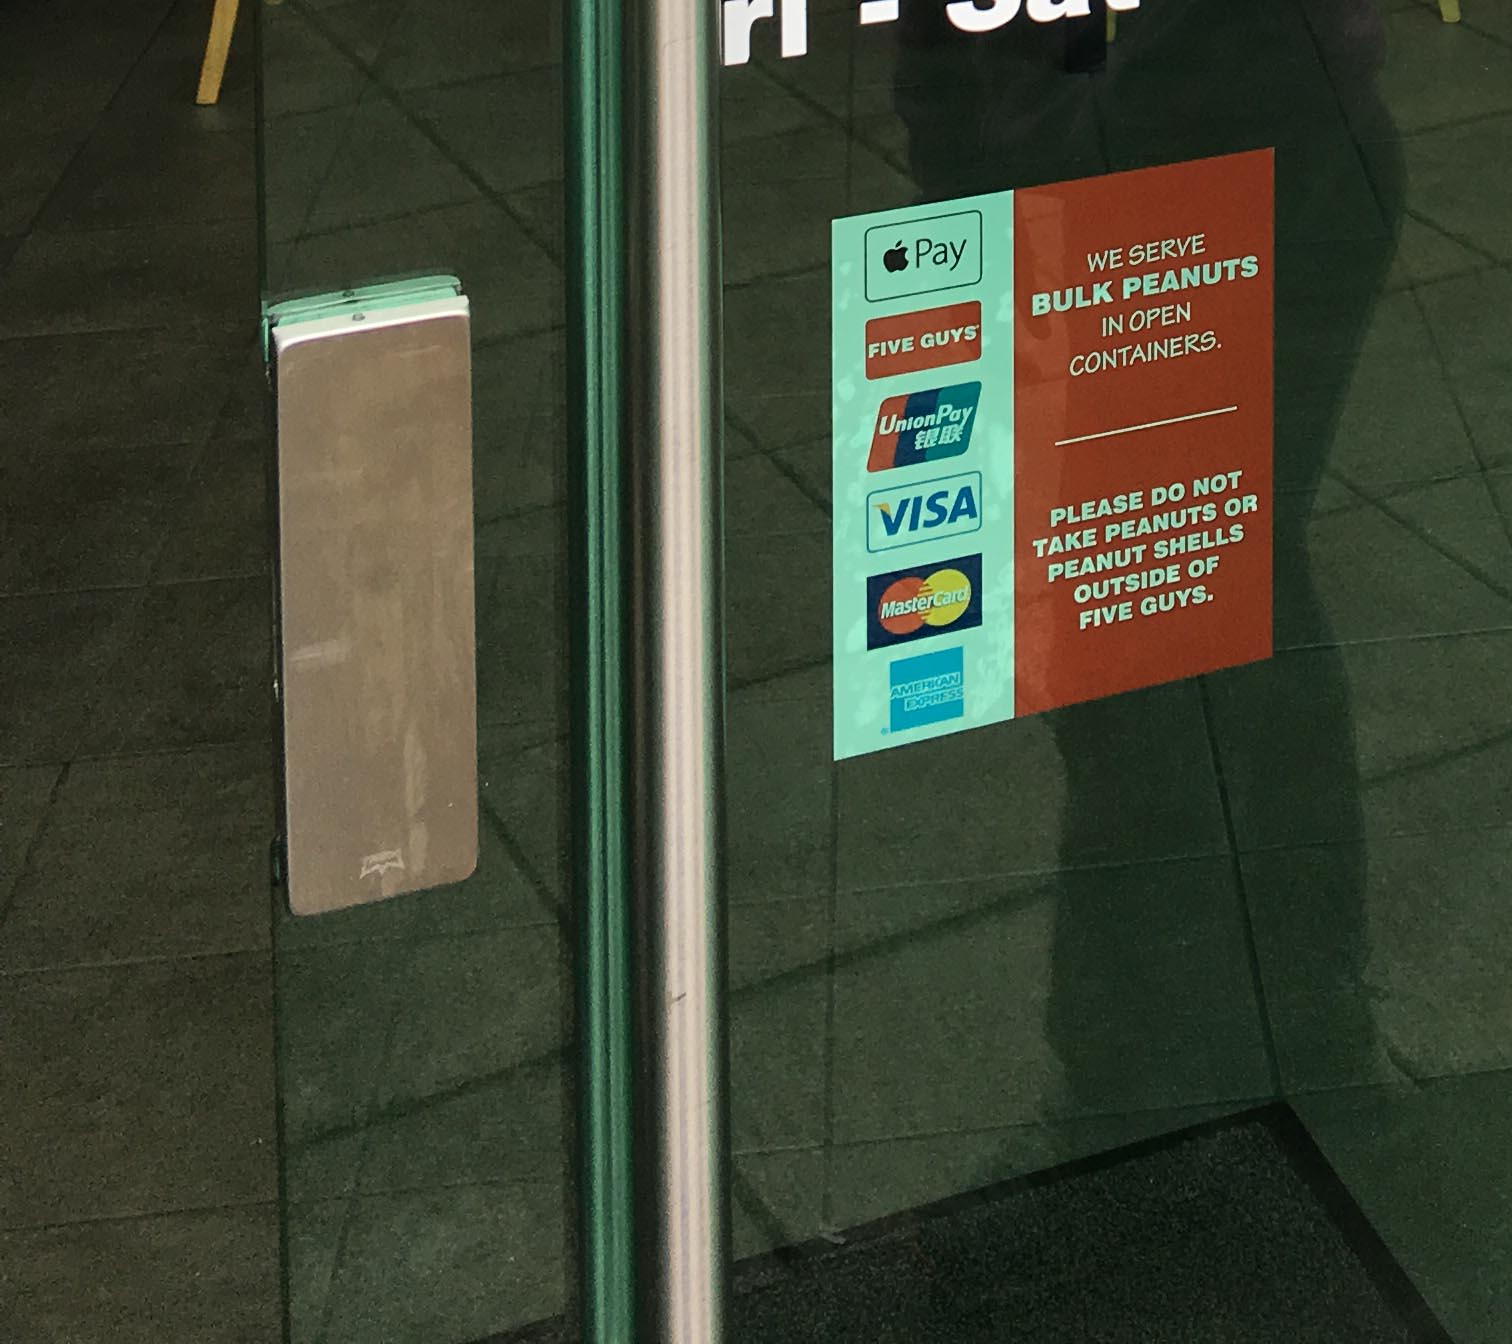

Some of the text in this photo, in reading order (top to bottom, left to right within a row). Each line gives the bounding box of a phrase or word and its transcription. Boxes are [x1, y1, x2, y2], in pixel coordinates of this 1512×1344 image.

[916, 238, 968, 271] Pay
[1087, 233, 1206, 273] WE SERVE
[1032, 255, 1259, 316] BULK PEANUTS
[1101, 302, 1191, 337] IN OPEN
[868, 336, 915, 359] FIVE
[1069, 330, 1222, 377] CONTAINERS.
[879, 403, 974, 437] UnionPay
[914, 424, 964, 451] 银联
[872, 485, 978, 536] VISA
[1050, 470, 1243, 527] PLEASE DO NOT
[1032, 494, 1258, 558] TAKE PEANUTS OR
[1048, 524, 1245, 583] PEANUT SHELLS
[1073, 555, 1220, 604] OUTSIDE OF
[880, 584, 969, 620] MasterCard
[1079, 585, 1214, 630] FIVE GUYS.
[890, 671, 960, 700] AMERICAN
[904, 687, 964, 712] EXPRESS
